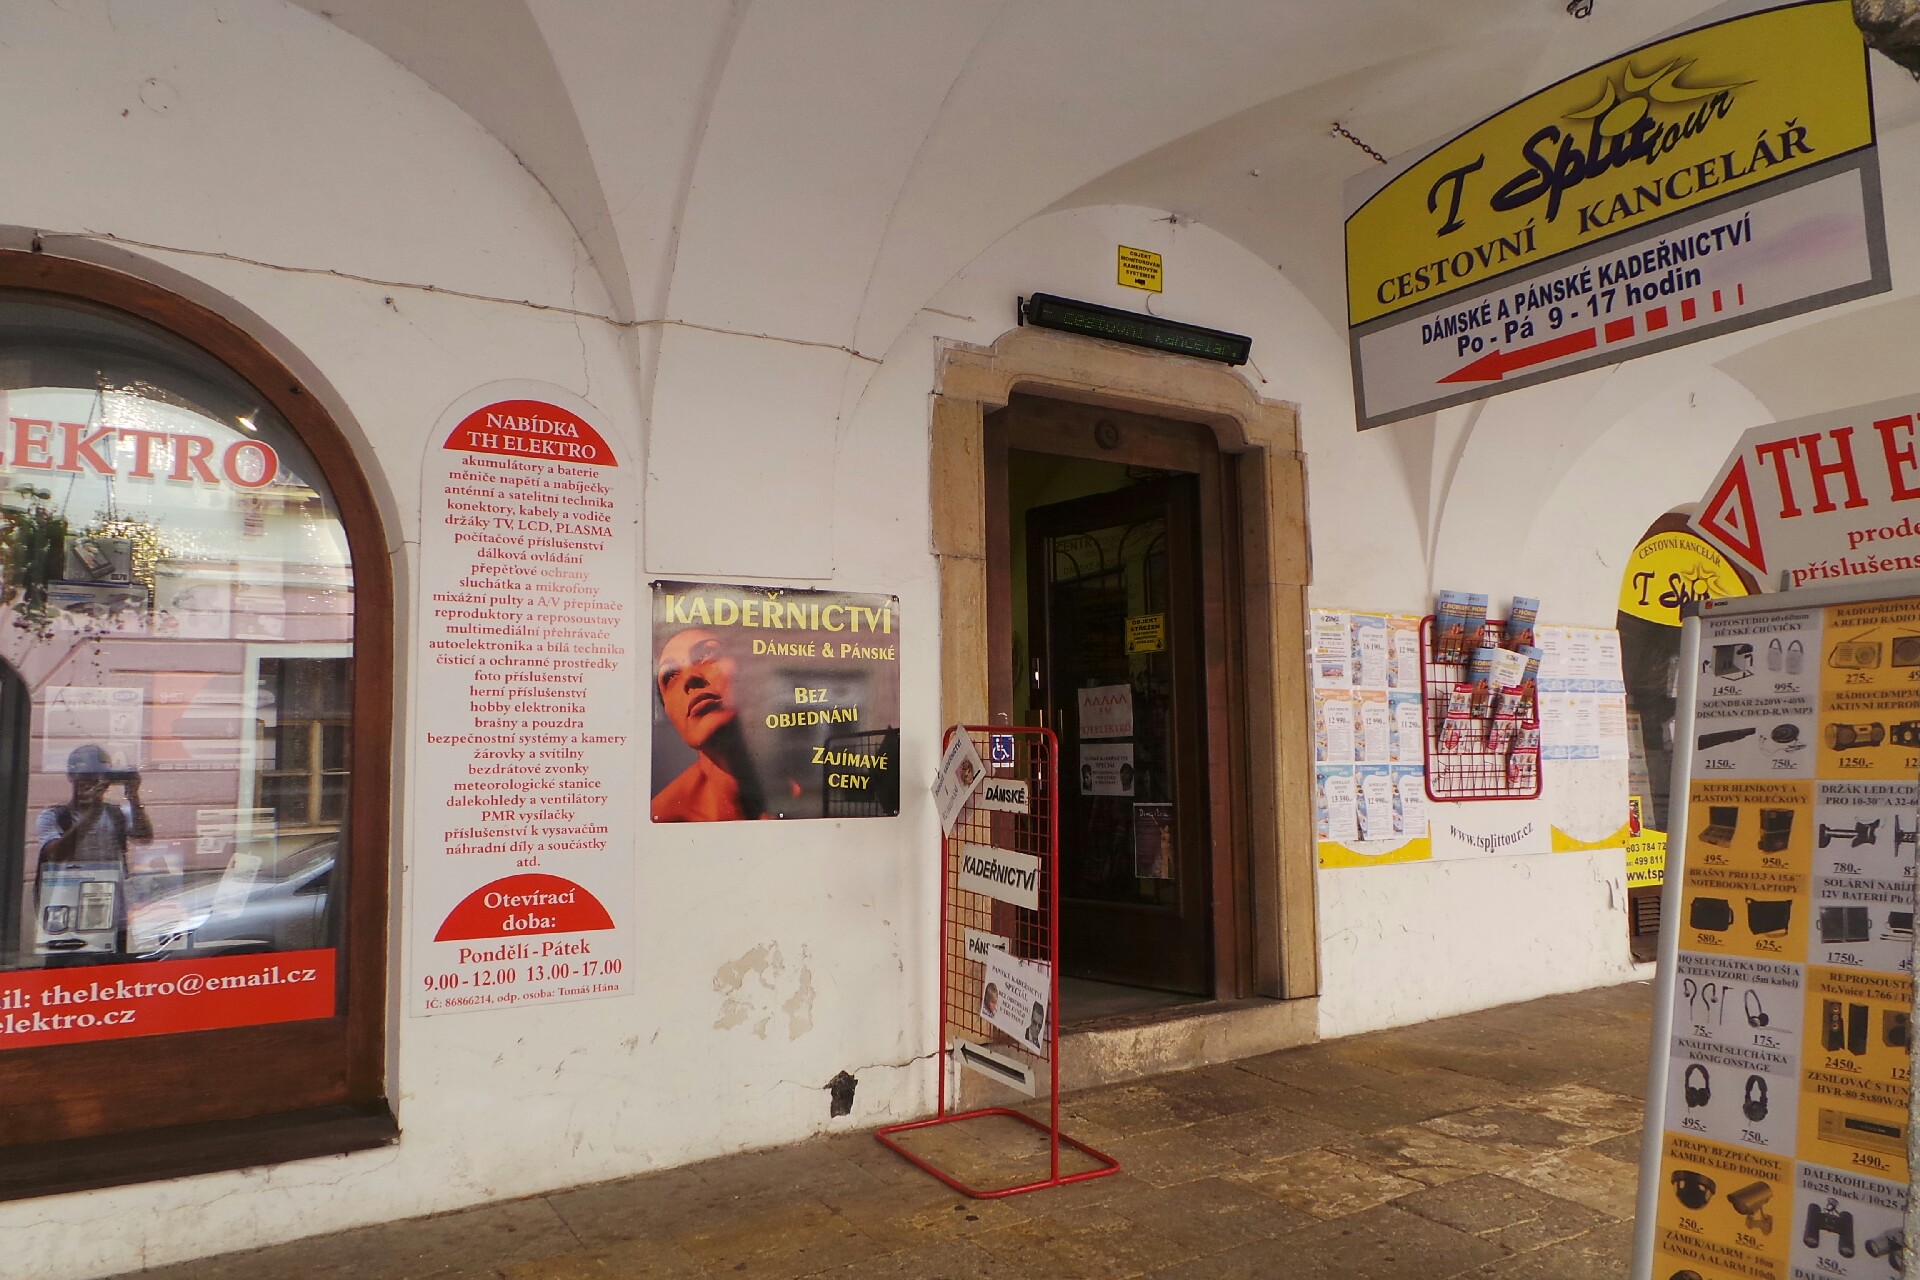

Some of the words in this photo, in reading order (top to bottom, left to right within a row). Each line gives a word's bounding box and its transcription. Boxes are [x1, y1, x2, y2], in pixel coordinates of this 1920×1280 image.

[1377, 217, 1537, 305] CESTOVNÍ
[1577, 116, 1816, 235] KANCELÁŘ
[1422, 299, 1491, 345] DÁMSKÉ
[1497, 298, 1510, 321] A
[1515, 265, 1593, 314] PÁNSKÉ
[1598, 211, 1752, 288] KADEŘNICTVÍ
[1457, 334, 1483, 357] Po
[1504, 319, 1534, 343] Pá
[1549, 306, 1562, 330] 9
[1586, 287, 1616, 317] 17
[1626, 266, 1701, 307] hodin
[486, 412, 579, 439] NABÍDKA
[0, 417, 279, 489] EKTRO
[466, 430, 498, 449] TH
[502, 435, 597, 460] ELEKTRO
[461, 455, 544, 474] akumulátory
[547, 465, 554, 474] a
[557, 465, 599, 479] baterie
[1755, 426, 1869, 519] TH
[448, 470, 496, 483] měniče
[500, 474, 540, 488] napětí
[543, 479, 550, 488] a
[553, 477, 610, 495] nabíječky
[444, 484, 494, 498] anténní
[498, 490, 505, 499] a
[508, 488, 559, 504] satelitní
[562, 495, 614, 508] technika
[445, 516, 490, 529] držáky
[493, 517, 514, 531] TV,
[555, 523, 613, 537] PLASMA
[454, 531, 524, 546] počítačové
[527, 536, 604, 551] příslušenství
[477, 547, 527, 561] dálková
[530, 551, 583, 564] ovládání
[1638, 536, 1679, 560] CESTOVNÍ
[1679, 539, 1721, 568] KANCELÁŘ
[540, 567, 590, 581] ochrany
[664, 592, 893, 634] KADEŘNICTVÍ
[1709, 617, 1769, 628] FOTOSTUDIO
[752, 639, 816, 657] DÁMSKÉ
[821, 642, 835, 658] &
[840, 643, 896, 661] PÁNSKÉ
[474, 669, 501, 681] foto
[504, 671, 583, 685] příslušenství
[469, 685, 505, 697] herní
[508, 687, 587, 701] příslušenství
[794, 687, 829, 704] BEZ
[1703, 699, 1753, 708] SOUNDBAR
[470, 701, 511, 716] hobby
[514, 701, 586, 713] elektronika
[765, 704, 858, 729] OBJEDNÁNÍ
[811, 746, 888, 770] ZAJÍMAVÉ
[1704, 758, 1736, 769] 2150,-
[1771, 758, 1797, 770] 750,-
[1838, 757, 1874, 768] 1250,-
[468, 763, 541, 775] bezdrátové
[544, 763, 589, 776] zvonky
[453, 778, 555, 793] meteorologické
[558, 779, 601, 789] stanice
[828, 773, 870, 790] CENY
[1821, 783, 1861, 794] DRŽÁK
[1825, 796, 1849, 805] PRO
[481, 810, 515, 822] PMR
[519, 808, 575, 823] vysílačky
[1450, 822, 1534, 852] www.tsplittour.cz
[1642, 842, 1655, 852] 784
[516, 855, 541, 868] atd.
[1634, 856, 1648, 865] 499
[1832, 862, 1862, 874] 780,-
[962, 854, 1036, 891] KADEŘNICTVÍ
[1823, 877, 1875, 890] SOLÁRNÍ
[483, 888, 575, 909] Otevírací
[502, 913, 556, 931] doba:
[458, 941, 529, 965] Pondělí
[541, 938, 591, 957] Pátek
[423, 974, 459, 992] 9.00
[472, 967, 516, 987] 12.00
[526, 963, 569, 983] 13.00
[582, 958, 622, 977] 17.00
[41, 966, 317, 1007] thelektro@email.cz
[497, 993, 520, 1004] odp.
[522, 988, 555, 999] osoba:
[558, 985, 590, 997] Tomáš
[592, 983, 619, 993] Hána
[0, 1008, 136, 1036] lektro.cz
[1678, 1038, 1723, 1052] KVALITNÍ
[1725, 1047, 1788, 1064] SLUCHÁTKA
[1689, 1051, 1721, 1063] KÖNIG
[1723, 1057, 1771, 1073] ONSTAGE
[1824, 1056, 1862, 1073] 2450,-
[1851, 1152, 1891, 1172] 2490,-
[1802, 1167, 1893, 1197] DALEKOHLEDY
